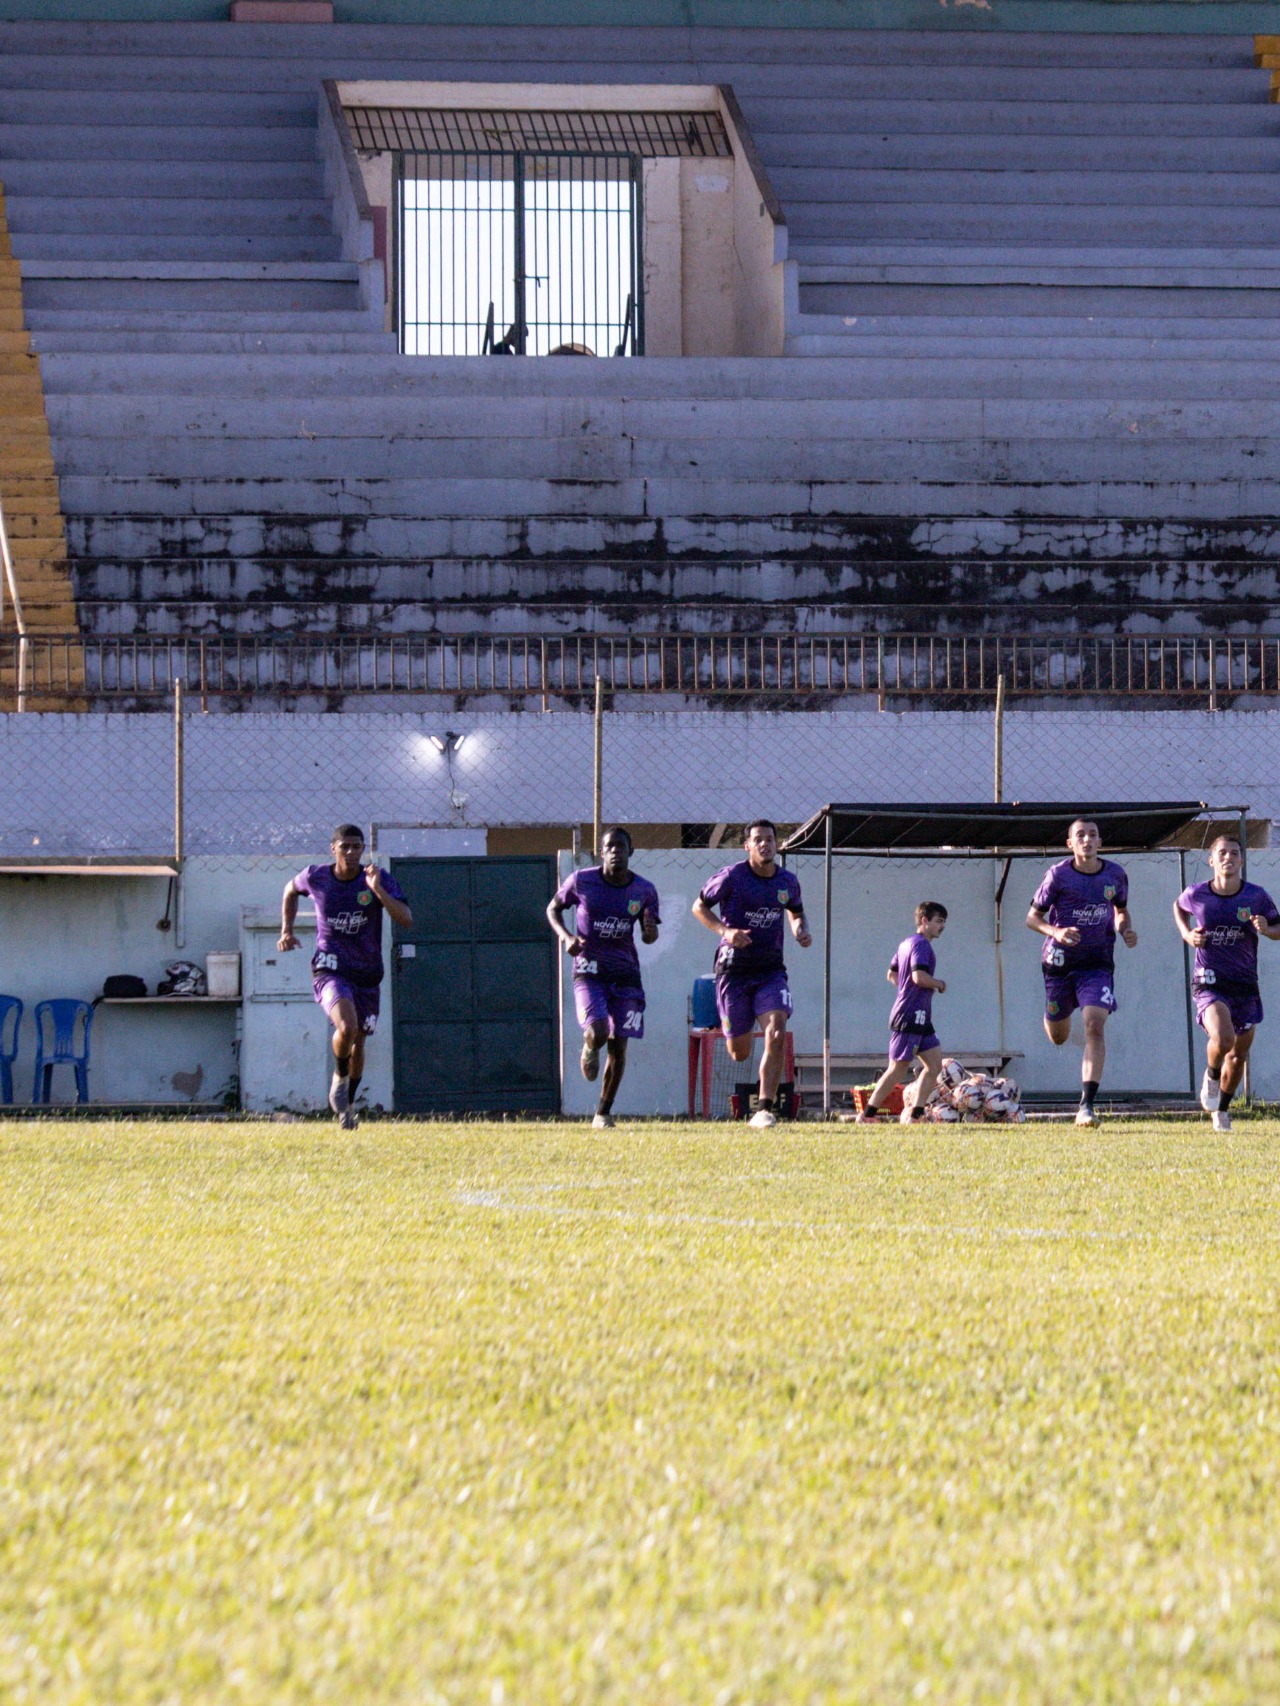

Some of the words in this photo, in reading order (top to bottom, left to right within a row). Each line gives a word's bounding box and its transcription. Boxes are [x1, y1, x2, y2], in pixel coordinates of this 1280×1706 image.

[316, 952, 338, 971] 26
[622, 1010, 643, 1031] 24
[914, 1009, 926, 1025] 16
